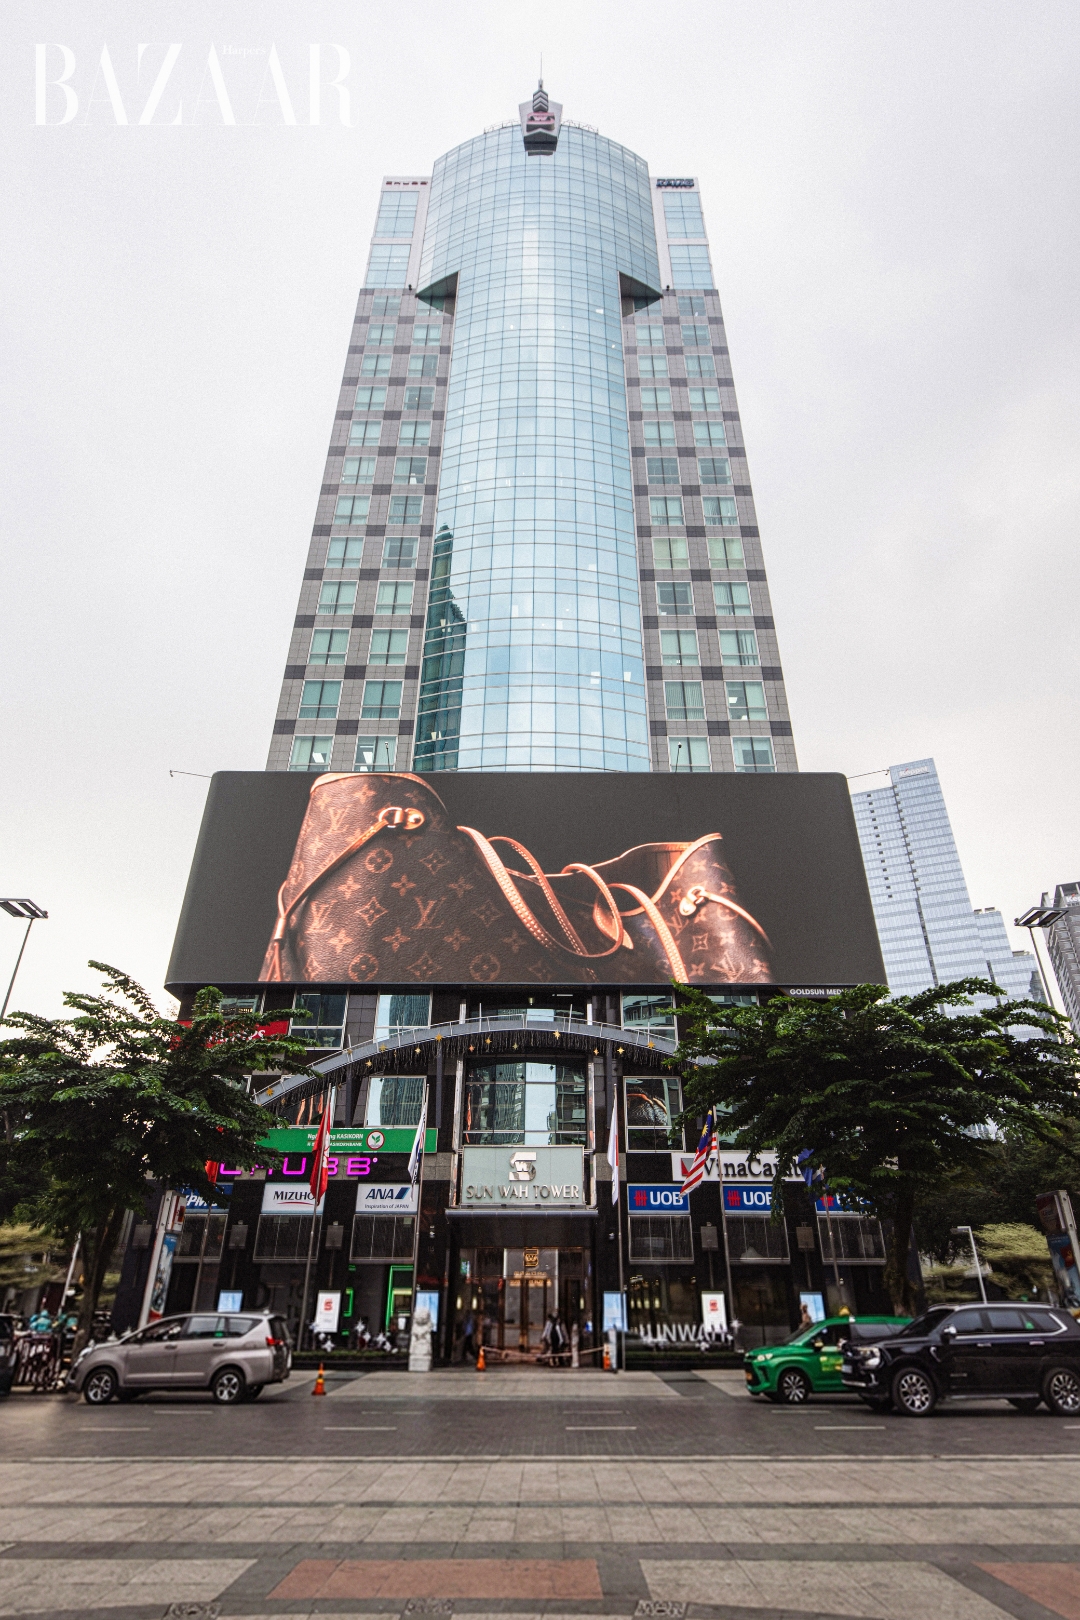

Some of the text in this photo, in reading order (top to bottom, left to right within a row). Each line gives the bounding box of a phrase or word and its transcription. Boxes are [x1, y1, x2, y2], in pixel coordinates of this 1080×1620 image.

[789, 988, 843, 996] GOLDSUN MED
[273, 1190, 316, 1201] MIZUHO
[365, 1188, 394, 1200] ANA
[466, 1185, 579, 1199] SUN WAH TOWER
[649, 1190, 684, 1206] UOB
